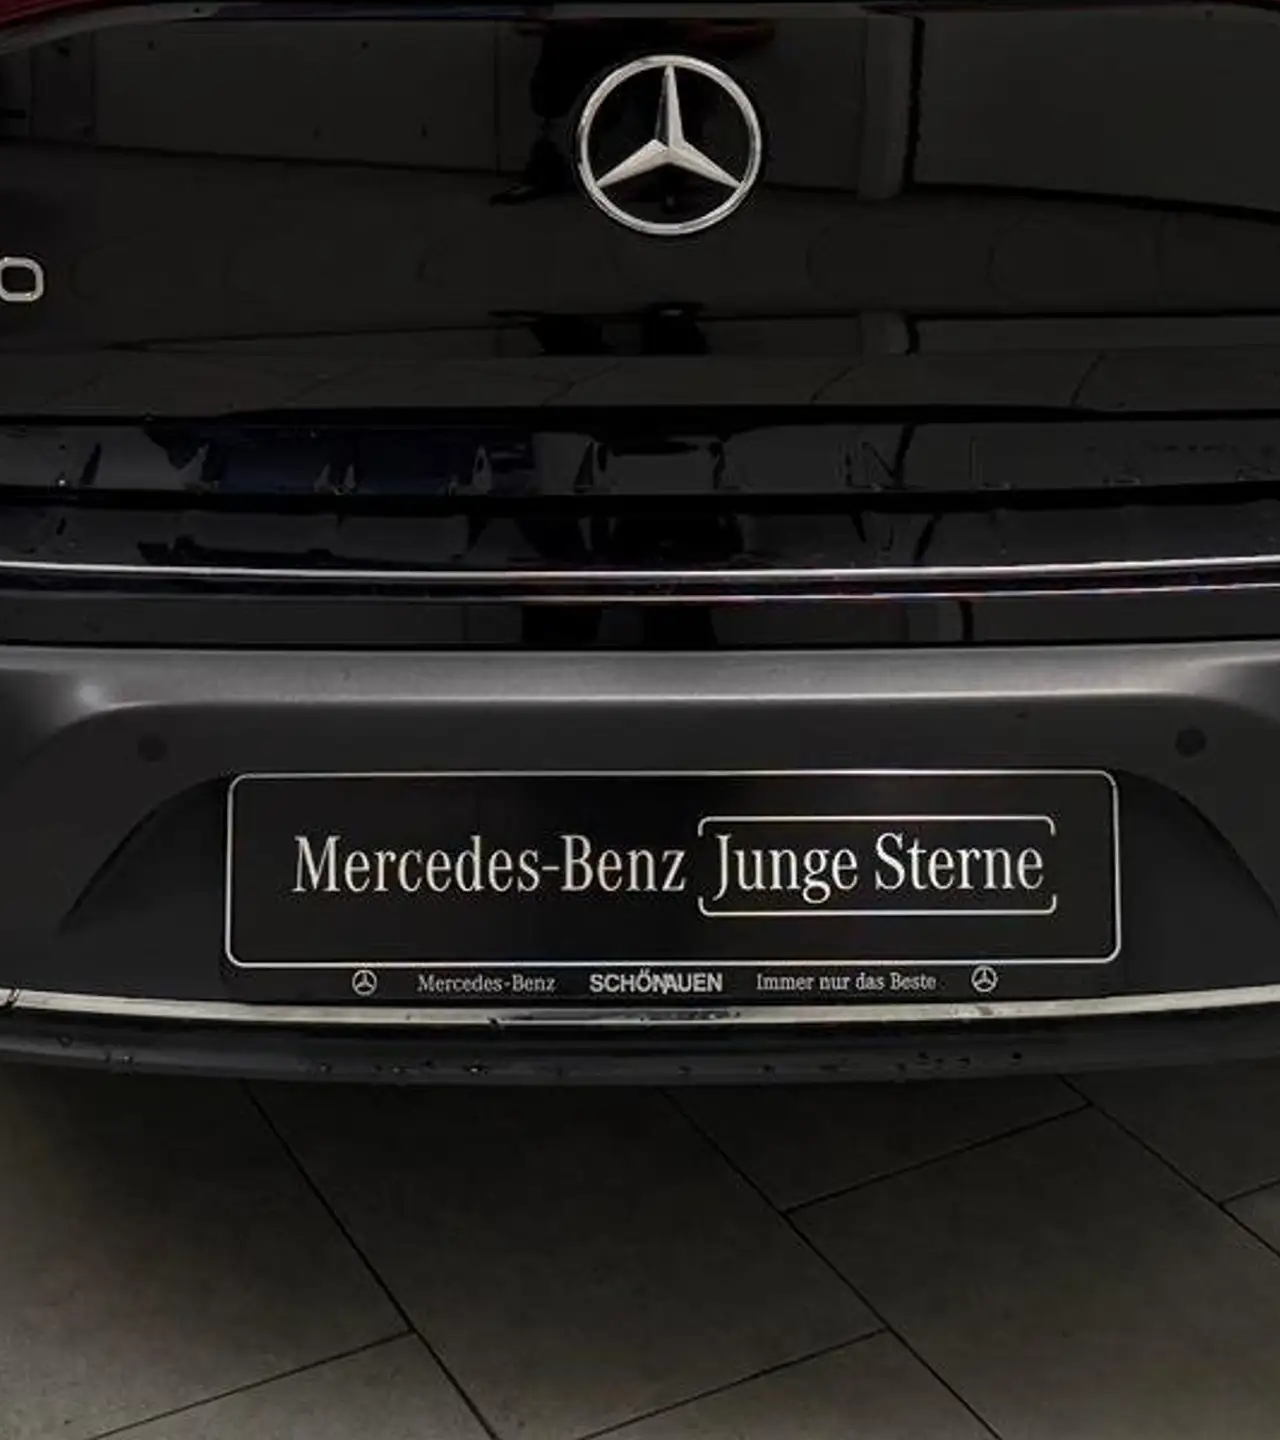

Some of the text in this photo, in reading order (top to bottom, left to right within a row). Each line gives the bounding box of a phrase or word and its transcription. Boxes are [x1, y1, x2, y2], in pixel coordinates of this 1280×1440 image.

[293, 833, 1044, 905] Mercedes-Benz Junge Sterne
[417, 973, 556, 994] Mercedes-Benz
[756, 972, 813, 991] Immer
[820, 975, 850, 991] nur
[856, 971, 885, 991] das
[890, 972, 937, 991] Beste
